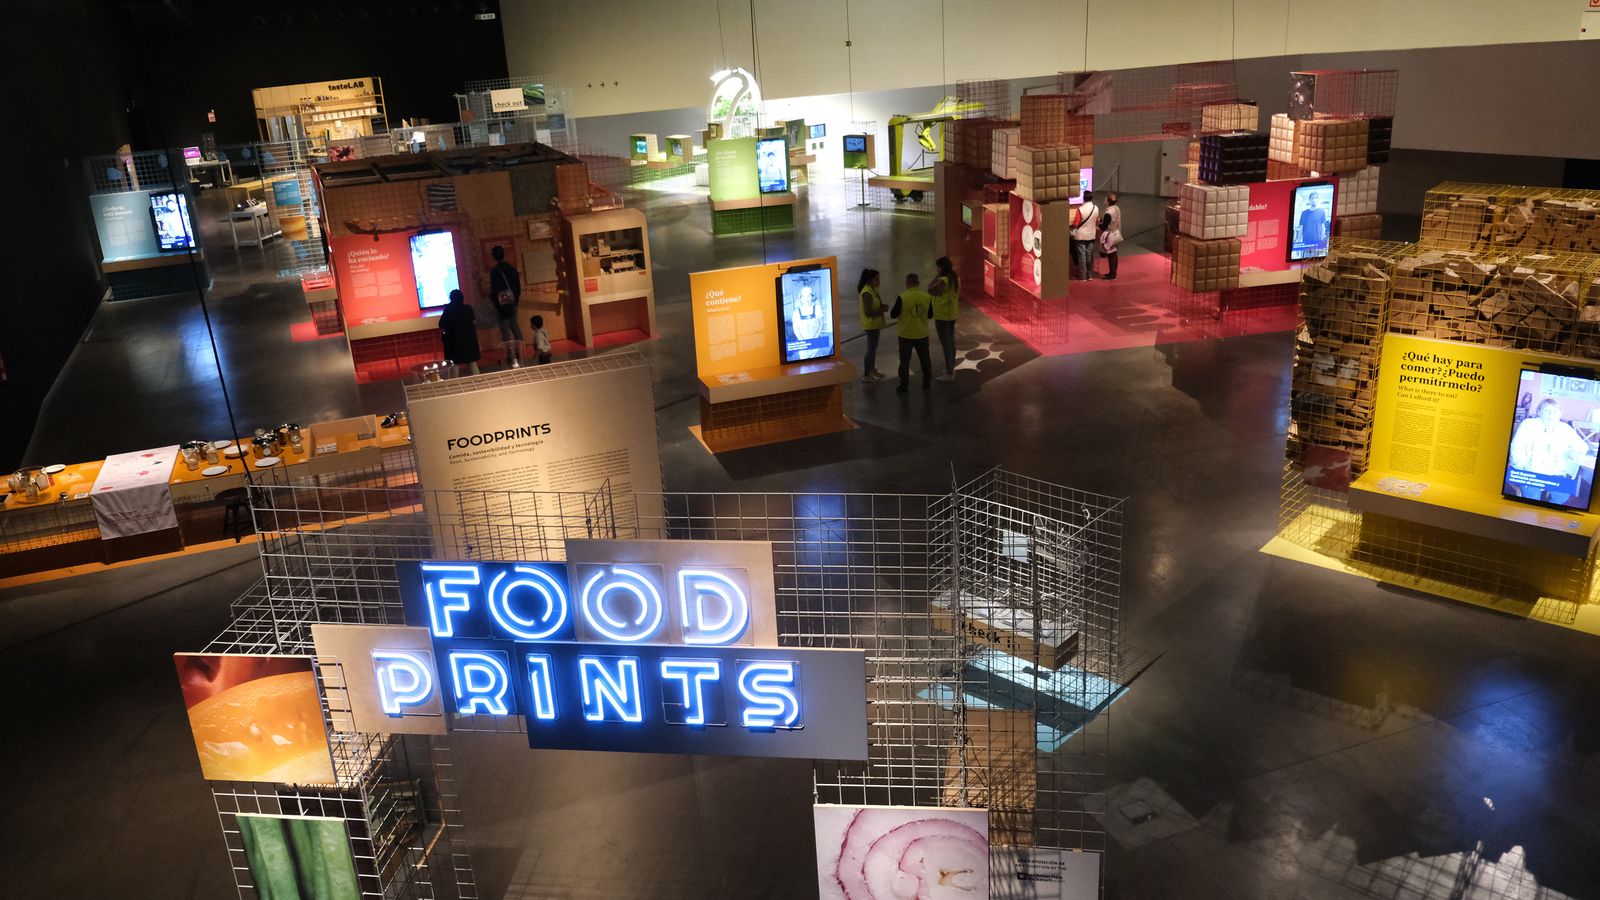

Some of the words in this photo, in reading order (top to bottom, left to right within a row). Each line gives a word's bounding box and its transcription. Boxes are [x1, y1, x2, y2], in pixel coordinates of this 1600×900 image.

[328, 81, 364, 91] tasteLAB
[1248, 203, 1268, 211] dable?
[357, 253, 389, 262] cocinado?
[706, 289, 724, 299] ¿Qué
[706, 295, 741, 306] contiene?
[1402, 350, 1430, 362] ¿Qué
[1433, 354, 1453, 367] hay
[1455, 359, 1483, 370] para
[1398, 385, 1414, 393] What
[1399, 374, 1483, 392] permitírmelo?
[447, 423, 551, 450] FOODPRINTS
[448, 451, 472, 460] Comida,
[472, 445, 511, 456] sostenibilidad
[421, 561, 751, 645] FOOD
[371, 650, 801, 729] PRINTS
